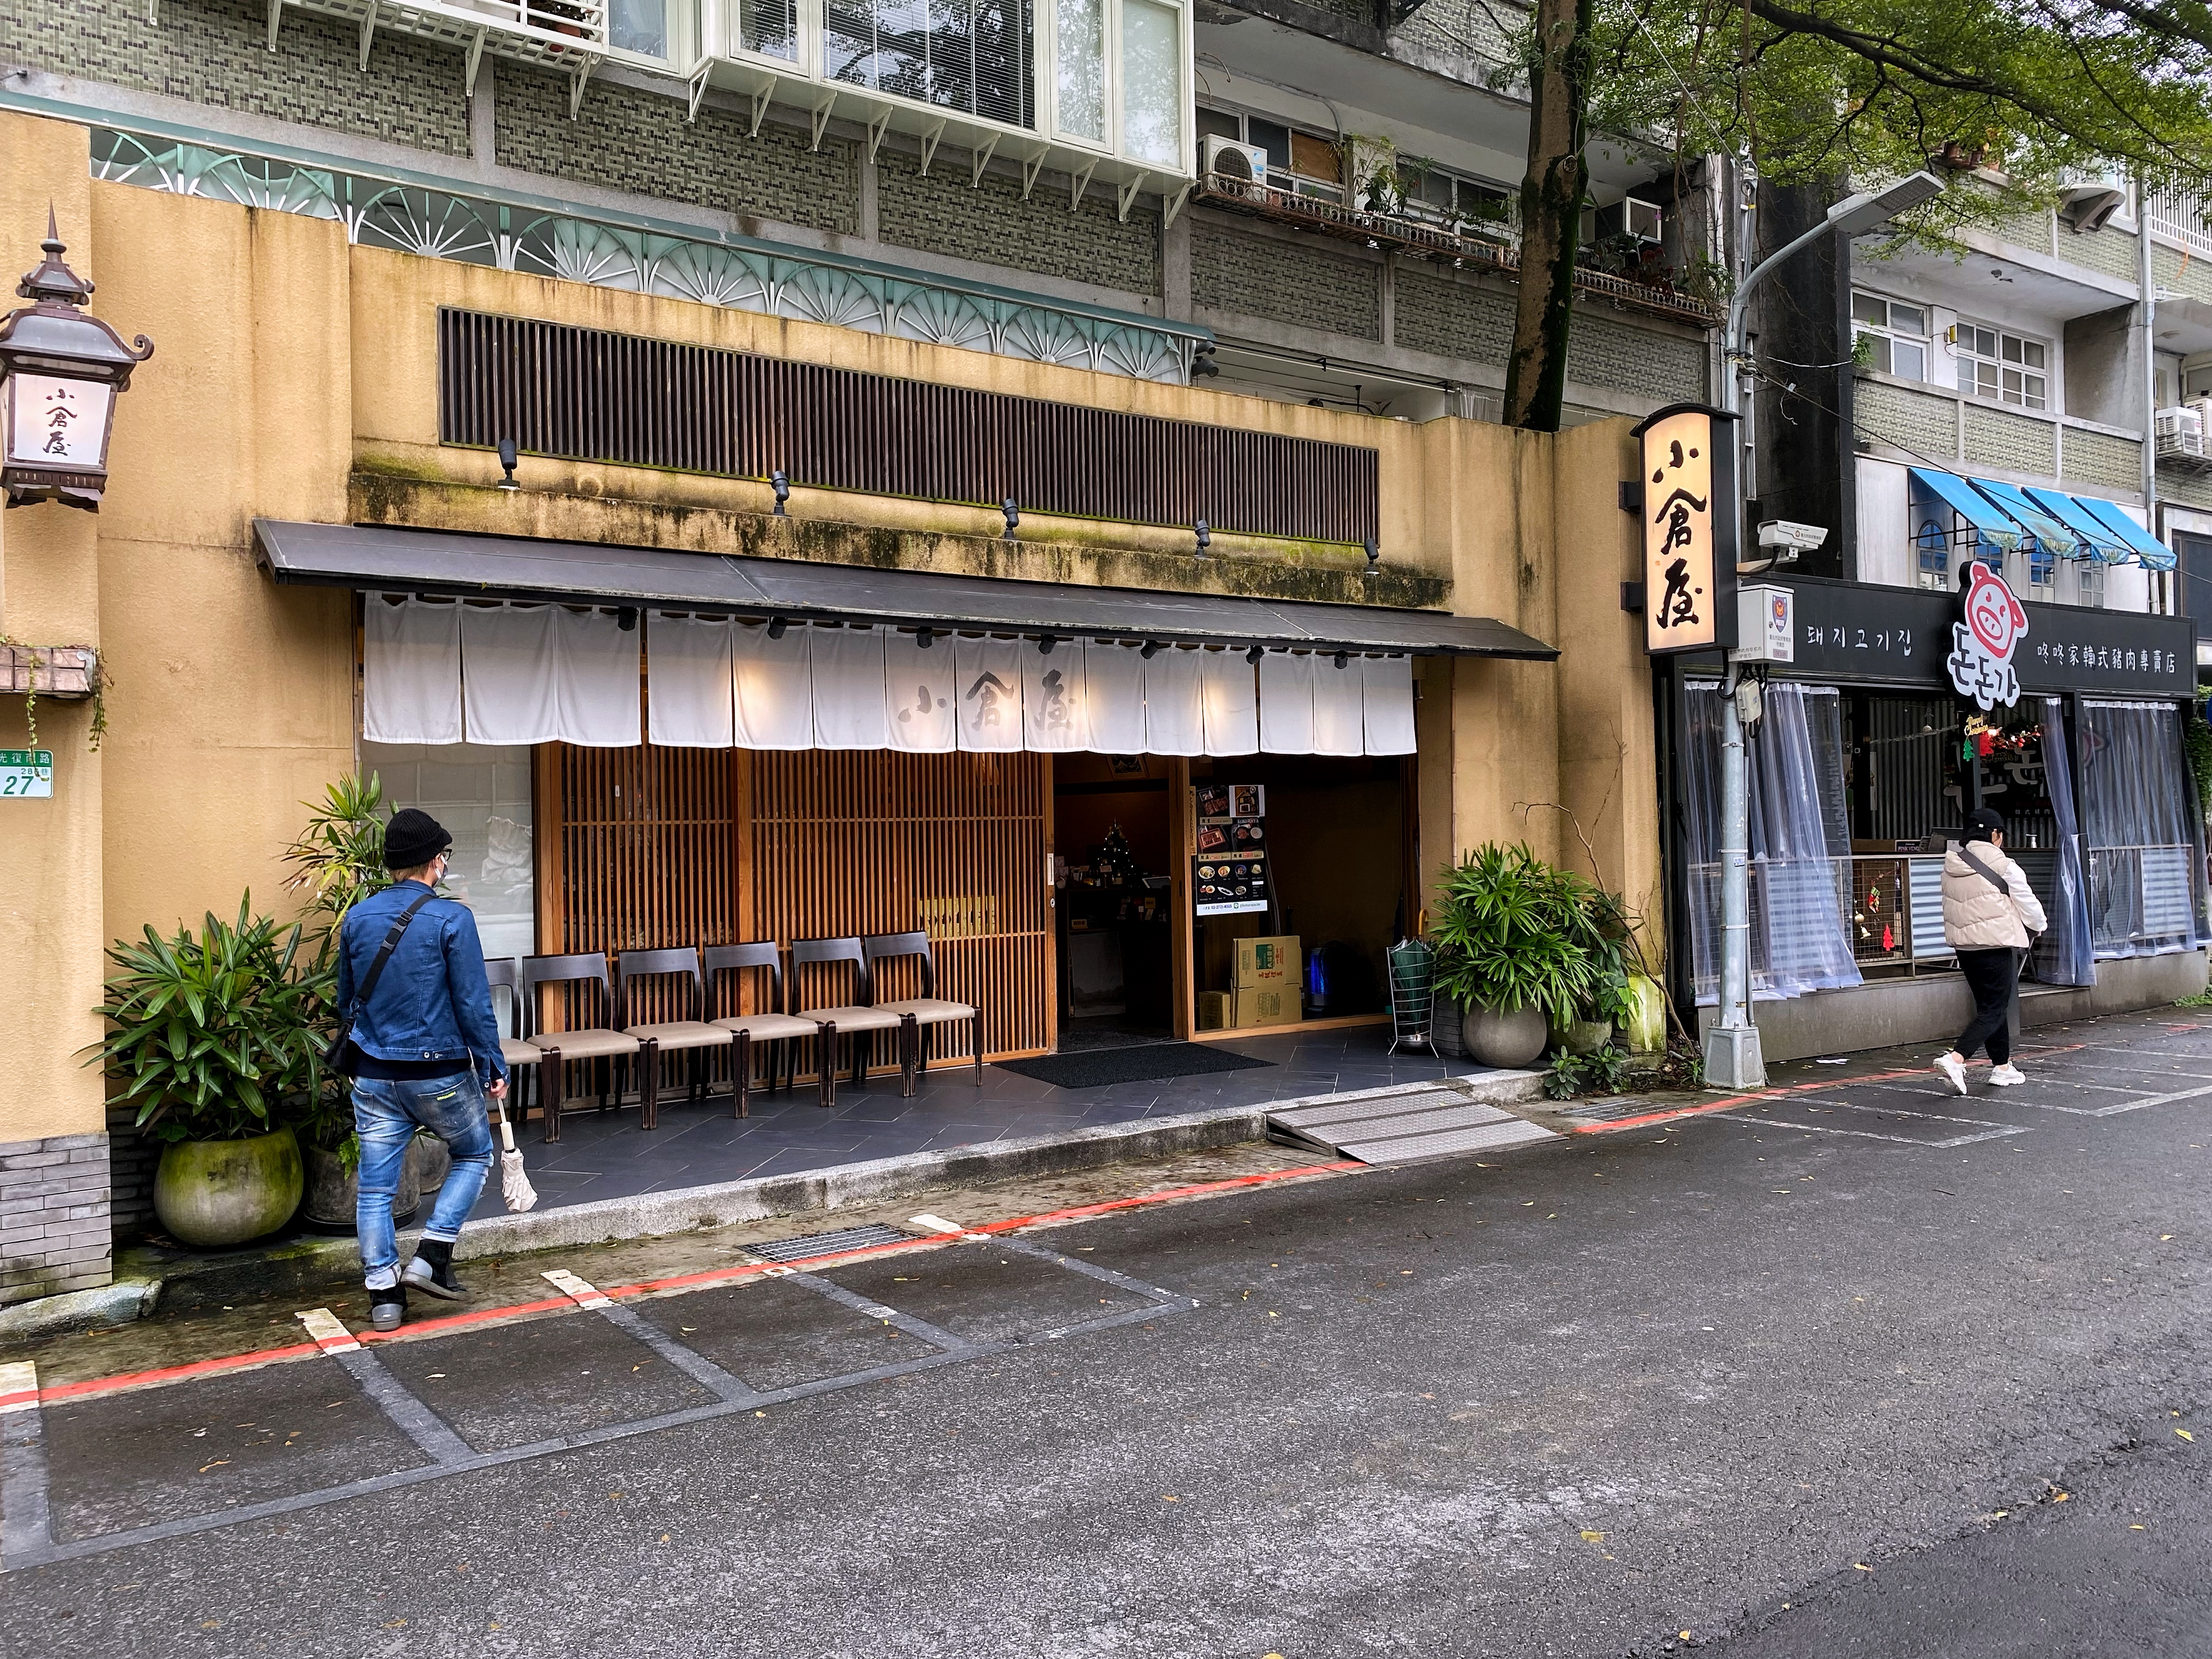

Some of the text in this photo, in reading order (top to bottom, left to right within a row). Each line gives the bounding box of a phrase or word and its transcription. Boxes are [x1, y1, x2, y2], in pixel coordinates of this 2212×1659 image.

[42, 387, 78, 456] 小倉屋
[1652, 439, 1707, 629] 小倉屋
[1807, 625, 1912, 657] 돼지고기집
[1950, 626, 2017, 702] 돈돈가
[2037, 641, 2176, 674] 咚咚家韓式豬肉專賣店
[898, 669, 1077, 732] 小倉屋
[3, 776, 34, 795] 27
